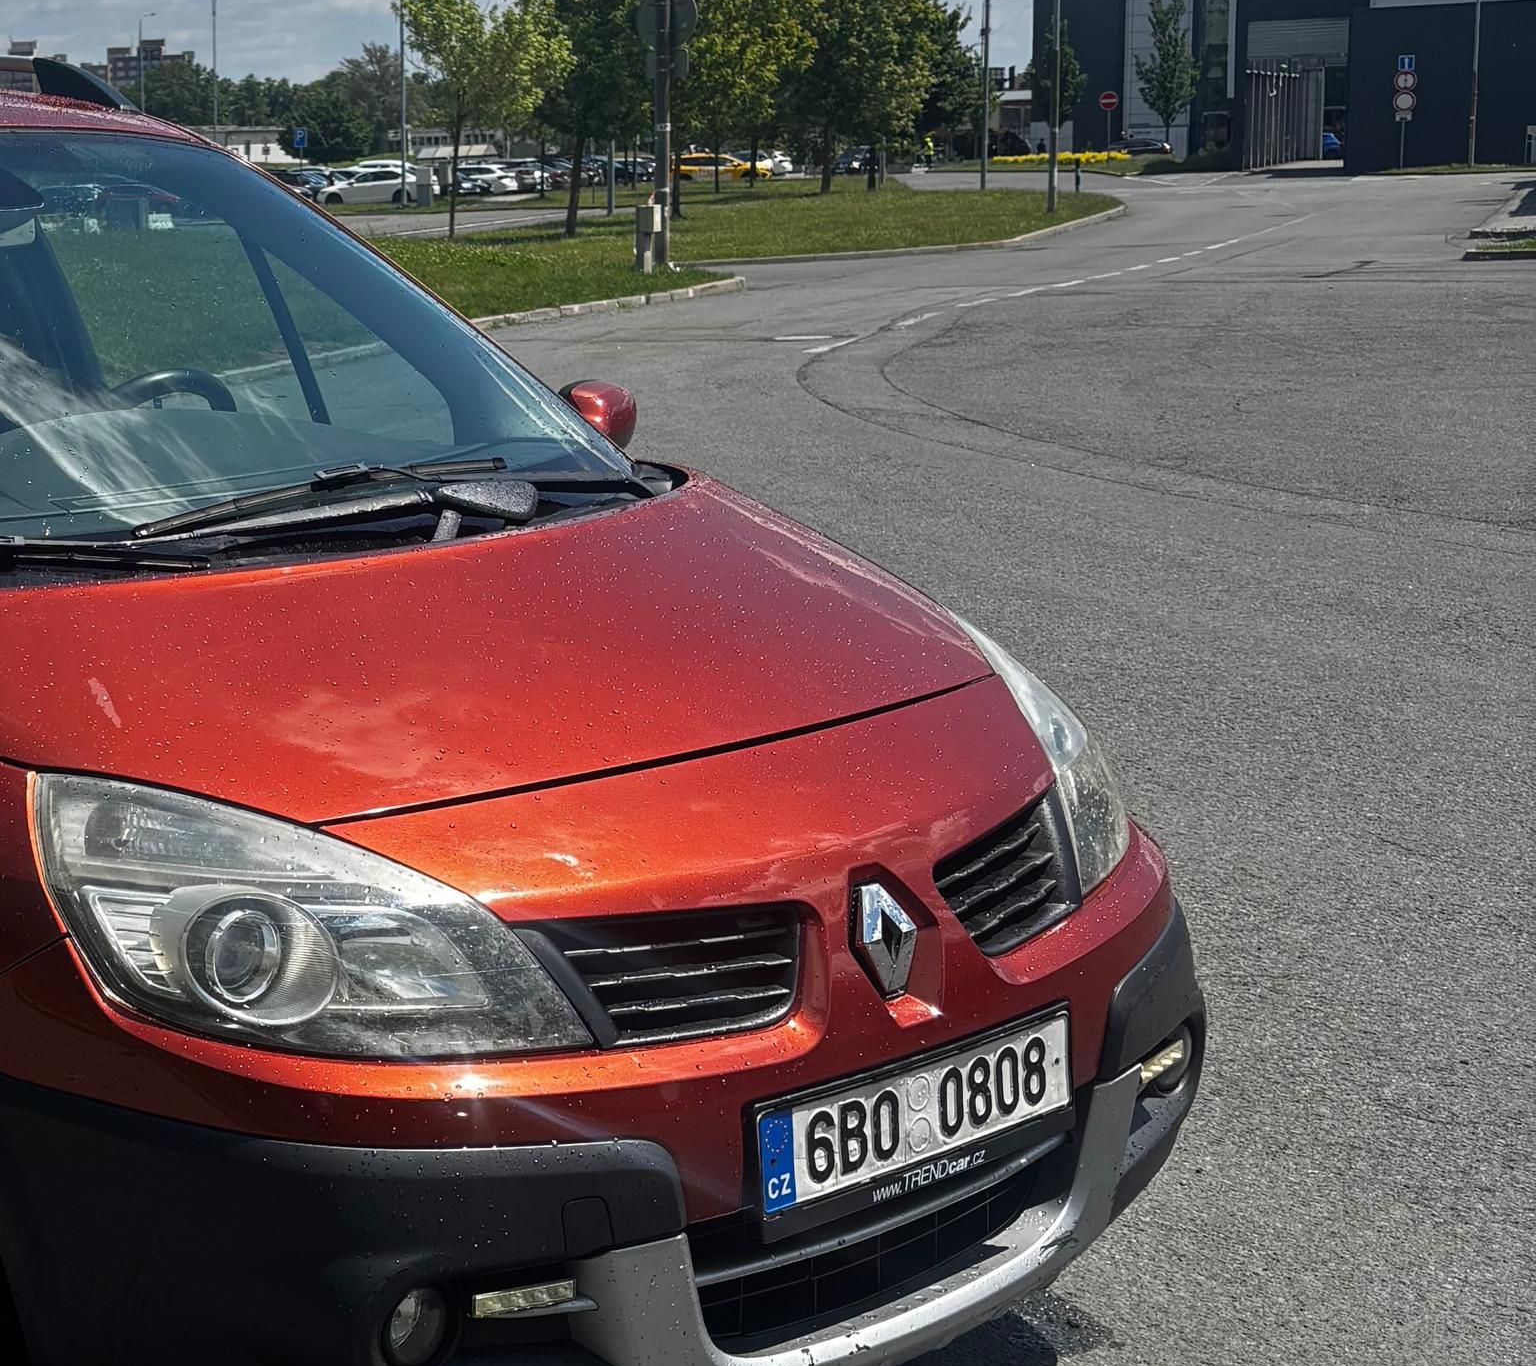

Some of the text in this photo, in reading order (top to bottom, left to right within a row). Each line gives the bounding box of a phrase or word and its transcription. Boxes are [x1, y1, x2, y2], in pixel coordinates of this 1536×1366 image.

[939, 1036, 1047, 1139] 0808
[768, 1173, 791, 1199] CZ
[872, 1150, 986, 1203] www.TRENDcar.cz
